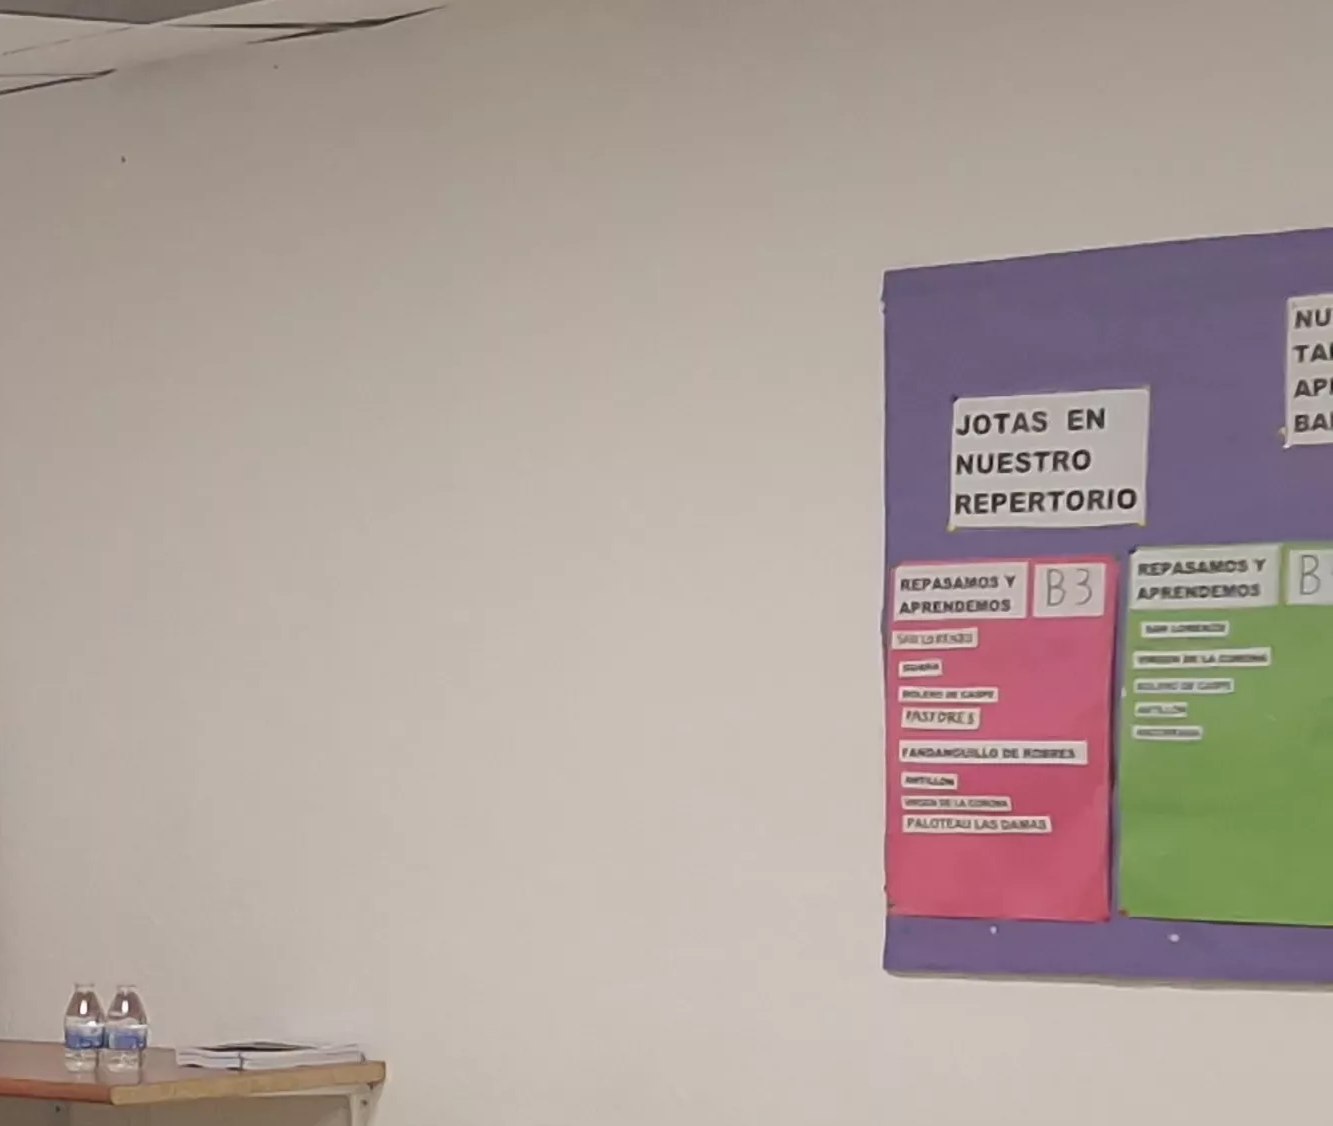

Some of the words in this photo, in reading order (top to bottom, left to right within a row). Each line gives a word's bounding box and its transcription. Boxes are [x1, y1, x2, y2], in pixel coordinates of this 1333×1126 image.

[1293, 342, 1333, 364] TA
[1294, 378, 1333, 398] AP
[956, 411, 1048, 436] JOTAS
[1067, 407, 1106, 431] EN
[1294, 412, 1333, 433] BA
[955, 449, 1092, 475] NUESTRO
[954, 488, 1138, 515] REPERTORIO
[1137, 560, 1249, 577] REPASAMOS
[1254, 558, 1267, 573] Y
[1300, 554, 1333, 595] B
[899, 575, 999, 592] REPASAMOS
[1004, 575, 1017, 589] Y
[1137, 583, 1262, 601] APRENDEMOS
[898, 599, 1012, 616] APRENDEMOS
